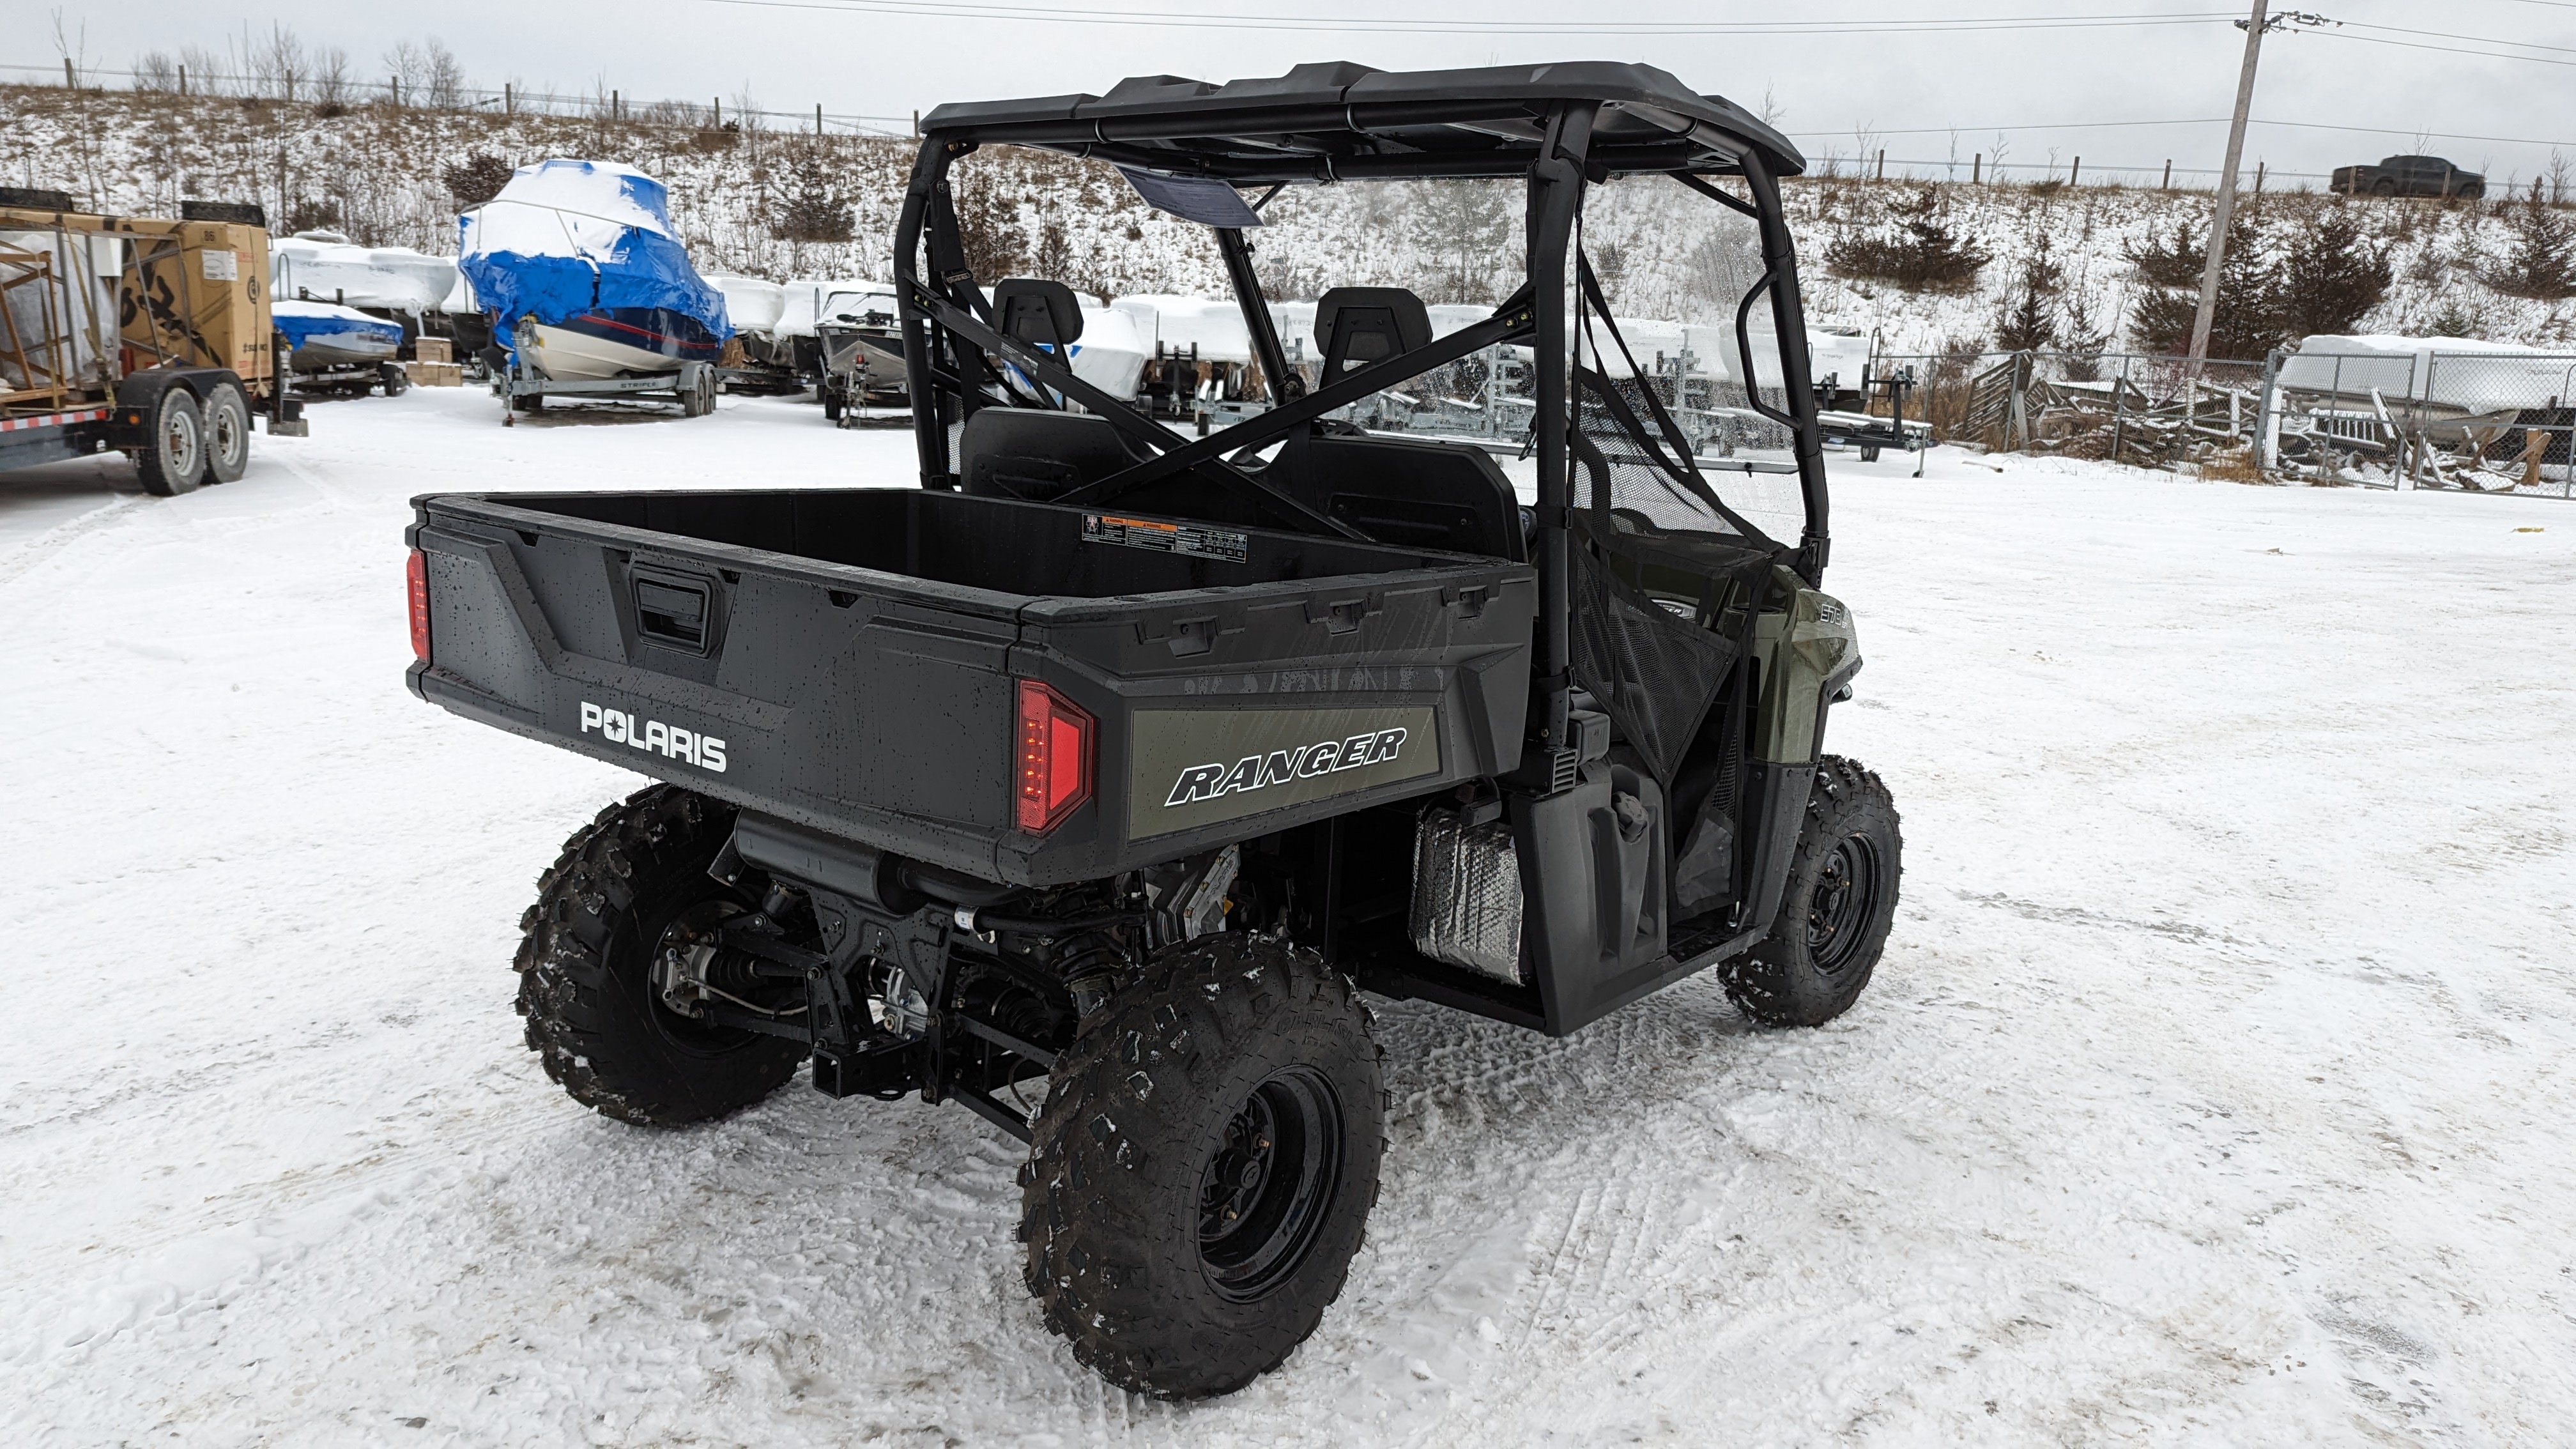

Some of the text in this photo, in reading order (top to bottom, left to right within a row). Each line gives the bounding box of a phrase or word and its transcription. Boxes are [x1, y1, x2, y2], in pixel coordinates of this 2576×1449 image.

[1820, 604, 1841, 625] 570
[581, 701, 726, 773] POLARIS
[1164, 727, 1407, 807] RANGER
[1277, 1013, 1365, 1060] CARLISLE
